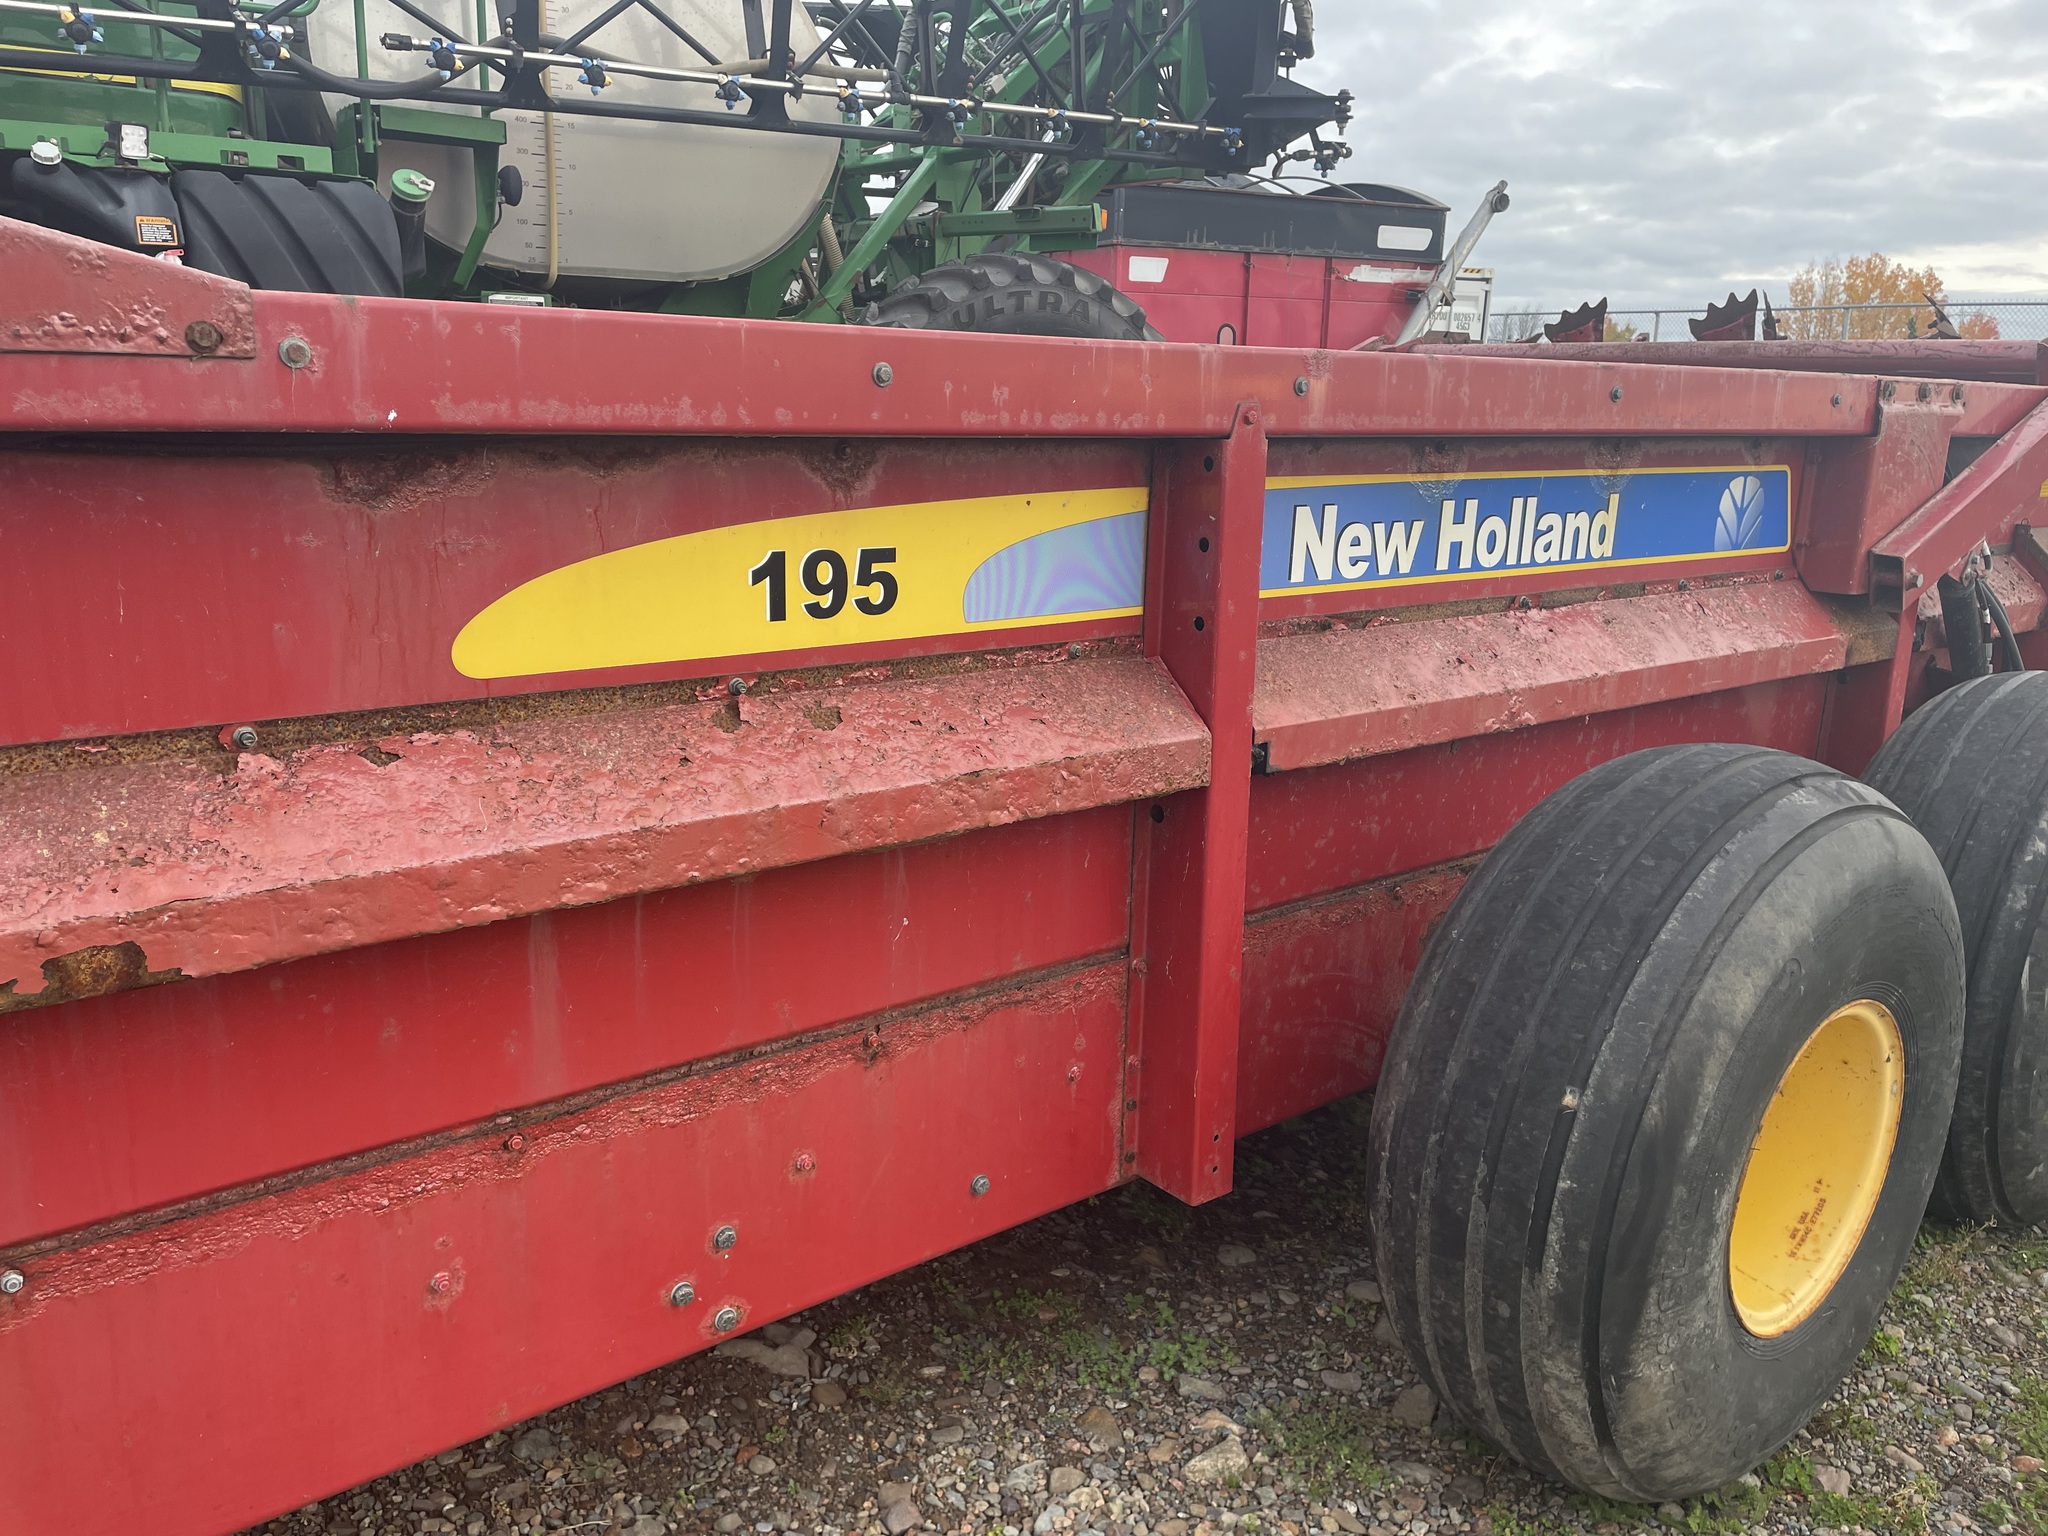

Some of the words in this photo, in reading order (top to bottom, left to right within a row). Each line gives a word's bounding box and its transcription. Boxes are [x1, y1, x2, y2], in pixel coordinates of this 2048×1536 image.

[952, 290, 1091, 330] ULTRA
[1289, 503, 1424, 583] New
[1435, 493, 1619, 571] Holland
[748, 546, 899, 622] 195
